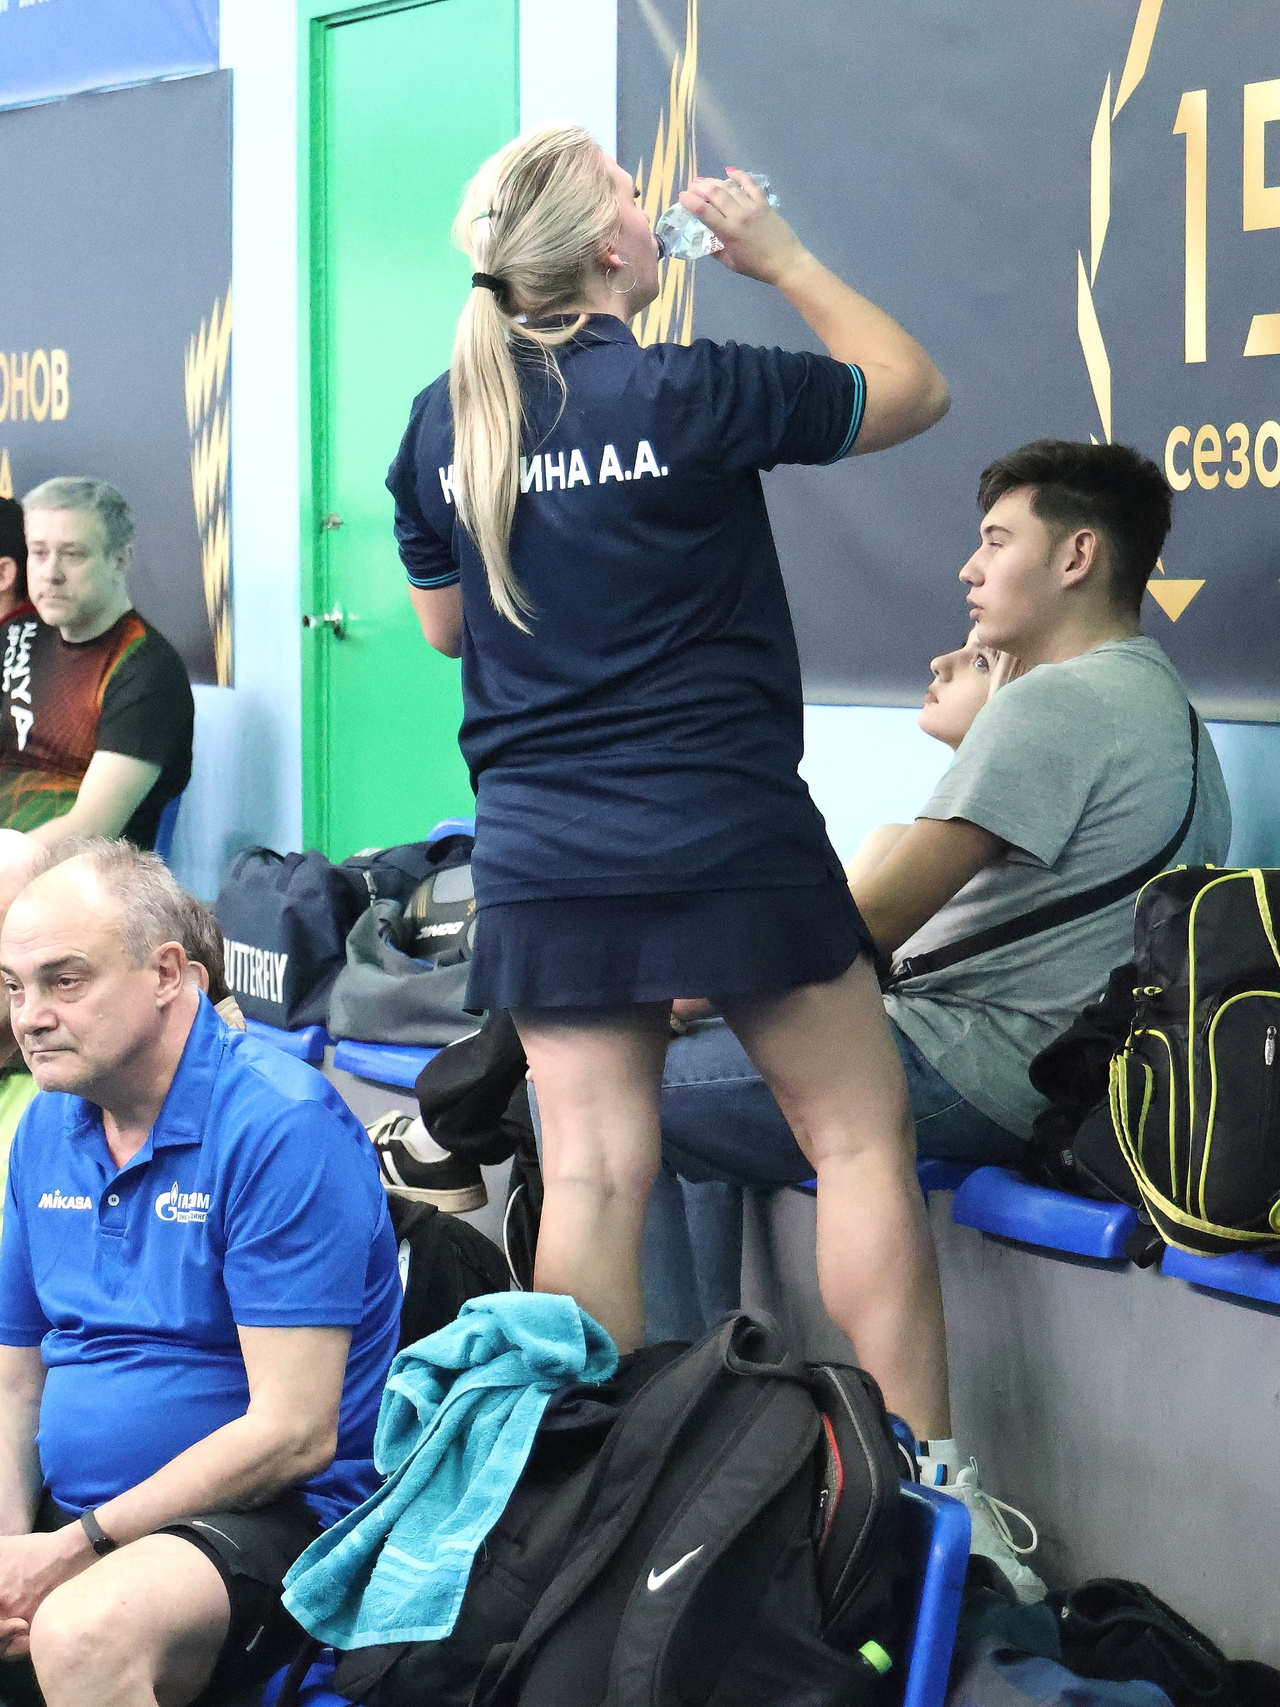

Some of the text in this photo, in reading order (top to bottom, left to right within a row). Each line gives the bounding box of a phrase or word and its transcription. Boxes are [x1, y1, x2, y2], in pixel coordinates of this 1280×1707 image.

[438, 440, 670, 504] КИНА А.А.
[222, 936, 289, 1004] UTTERFLY
